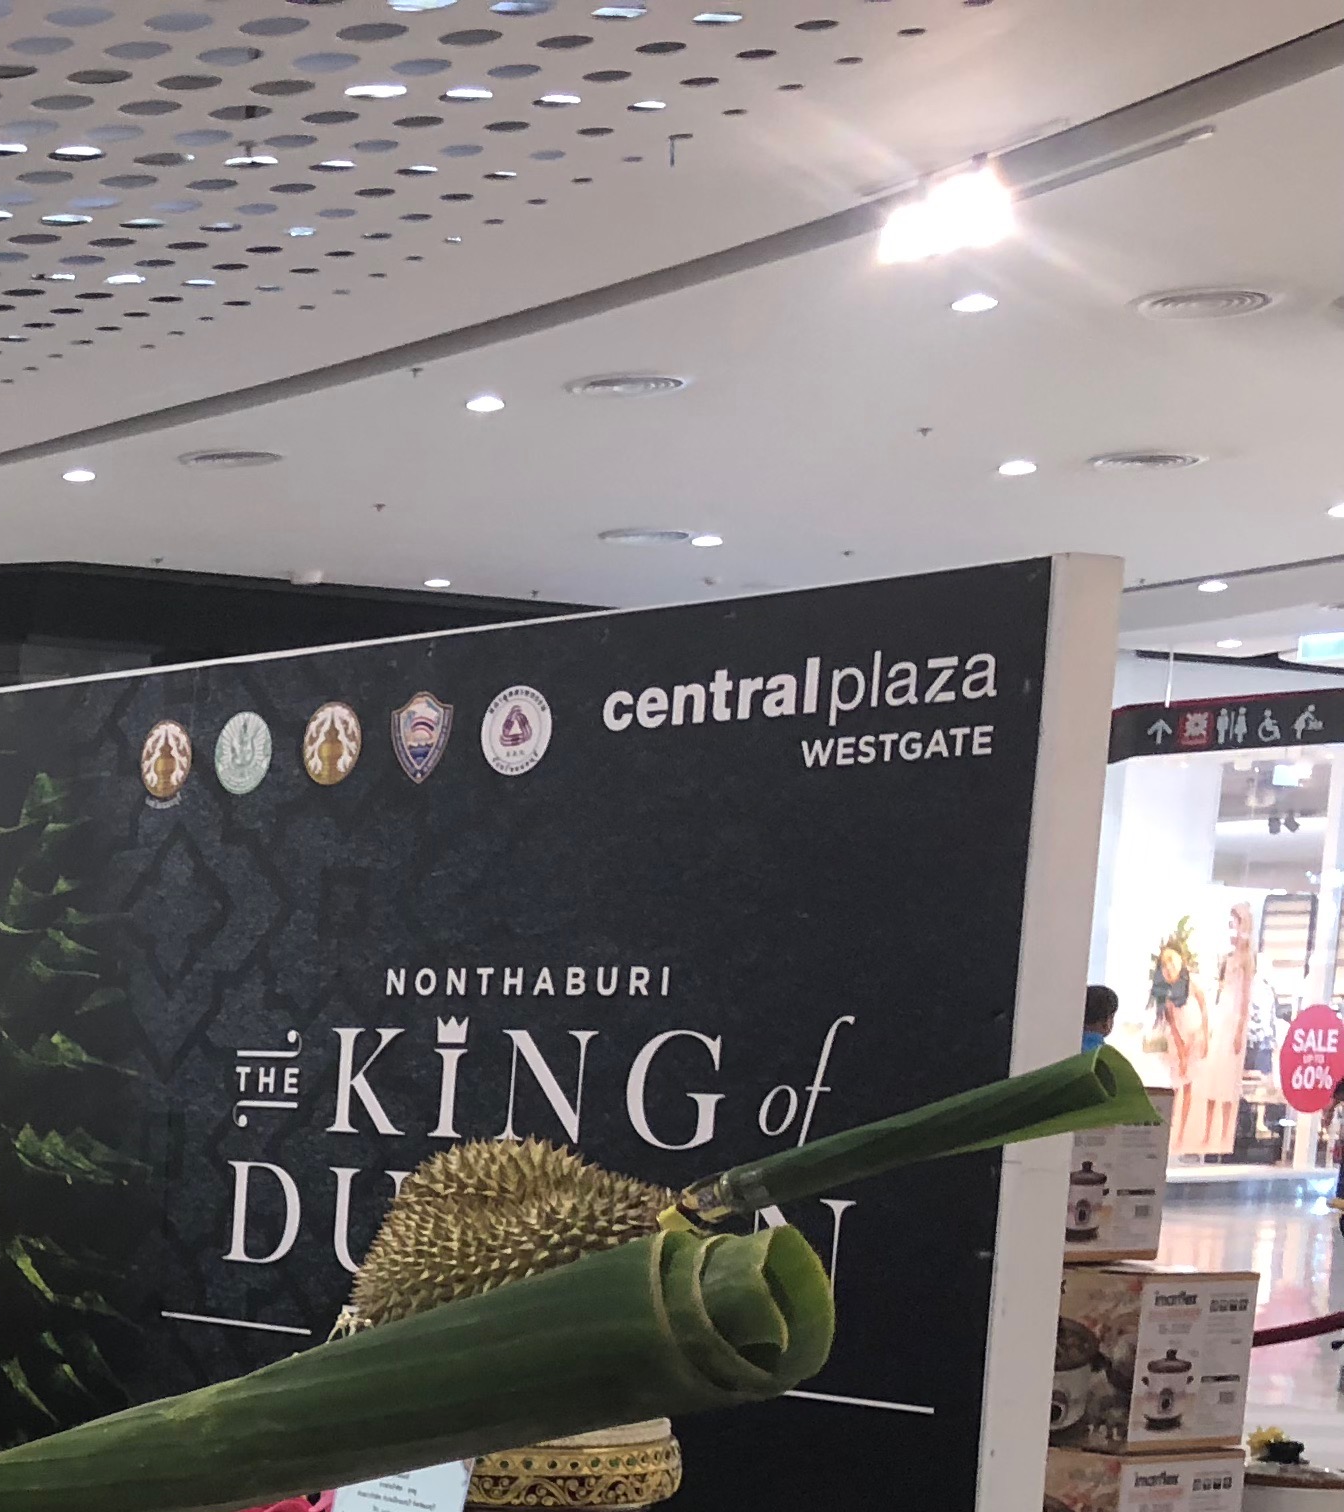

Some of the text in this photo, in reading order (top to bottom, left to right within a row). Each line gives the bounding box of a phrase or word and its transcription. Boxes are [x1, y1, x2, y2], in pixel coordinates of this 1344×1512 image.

[801, 726, 993, 769] WESTGATE
[385, 966, 673, 998] NONTHABURI
[1292, 1028, 1339, 1053] SALE
[235, 1014, 857, 1152] THE KING of
[1291, 1065, 1333, 1090] 60%
